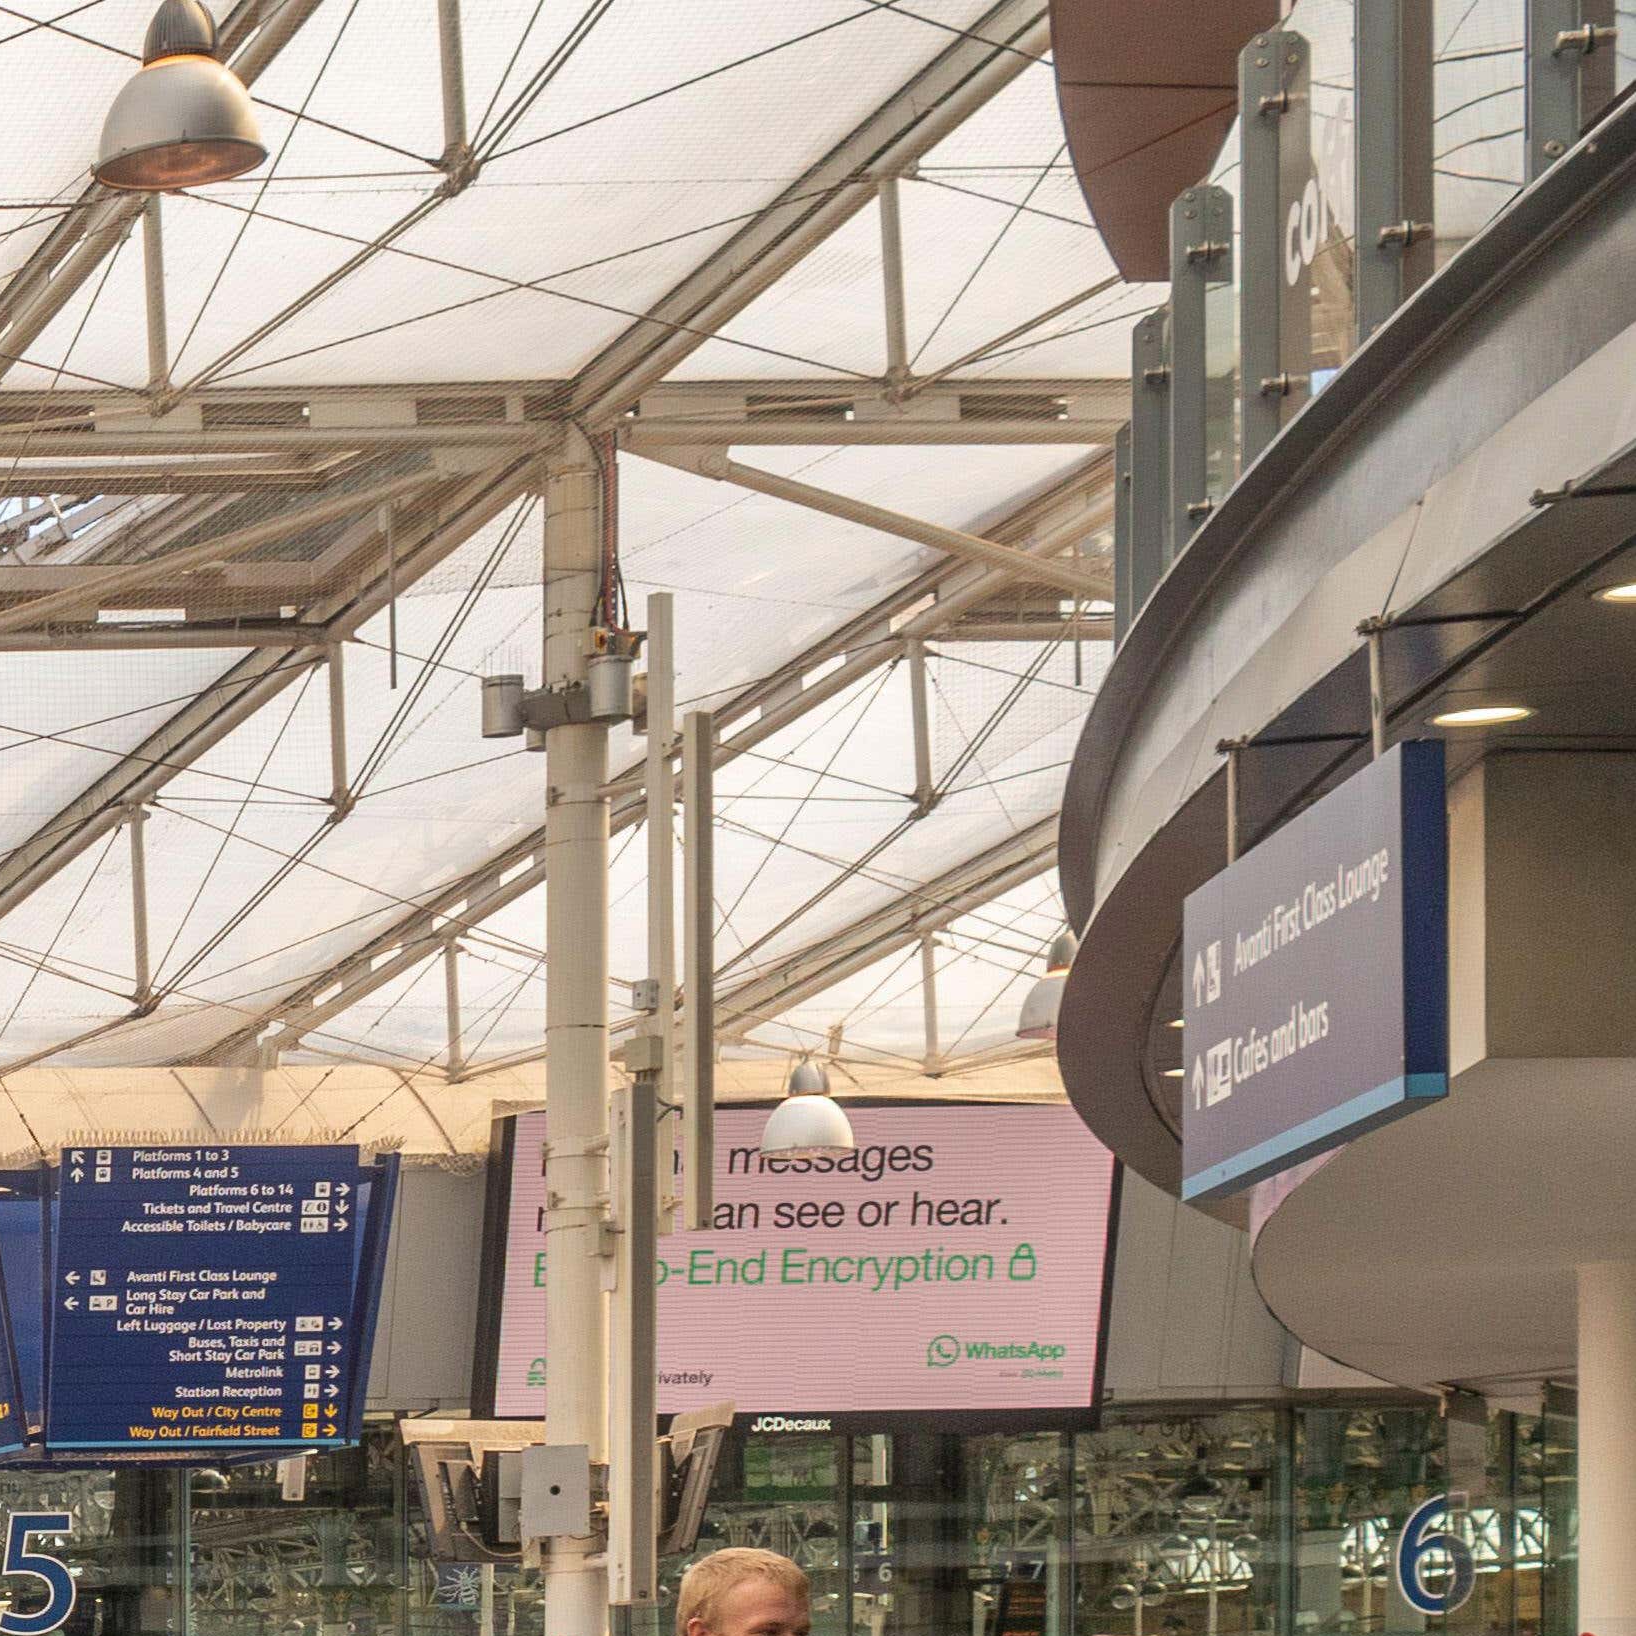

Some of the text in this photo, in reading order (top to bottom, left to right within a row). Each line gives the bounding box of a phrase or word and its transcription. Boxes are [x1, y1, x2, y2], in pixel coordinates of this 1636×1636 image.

[1233, 848, 1389, 976] Avanti First Class Lounge
[1233, 1000, 1328, 1082] Cafes and bars
[132, 1150, 229, 1162] Platforms 1 to 3
[132, 1167, 239, 1180] Platforms 4 and 5
[189, 1184, 294, 1196] Platforms 6 to 14
[143, 1202, 293, 1214] Tickets and Travel Centre
[774, 1192, 1008, 1228] see or hear.
[122, 1219, 292, 1233] Accessible Toilets Babycare
[781, 1245, 994, 1290] Encryption
[127, 1270, 277, 1283] Avanti First Class Lounge
[126, 1289, 265, 1304] Long Stay Car Park and
[126, 1303, 174, 1315] Car Hire
[117, 1319, 286, 1333] Left Luggage Lost Property
[189, 1336, 285, 1350] Buses, Taxis and
[169, 1349, 284, 1364] Short Stay Car Park
[966, 1342, 1066, 1360] WhatsApp
[226, 1366, 283, 1378] Metrolink
[175, 1386, 282, 1399] Station Reception
[152, 1405, 282, 1420] Way Out City Centre
[752, 1416, 831, 1432] JCDecaux
[129, 1424, 280, 1439] Way Out Fairfield Street
[1397, 1493, 1476, 1615] 6
